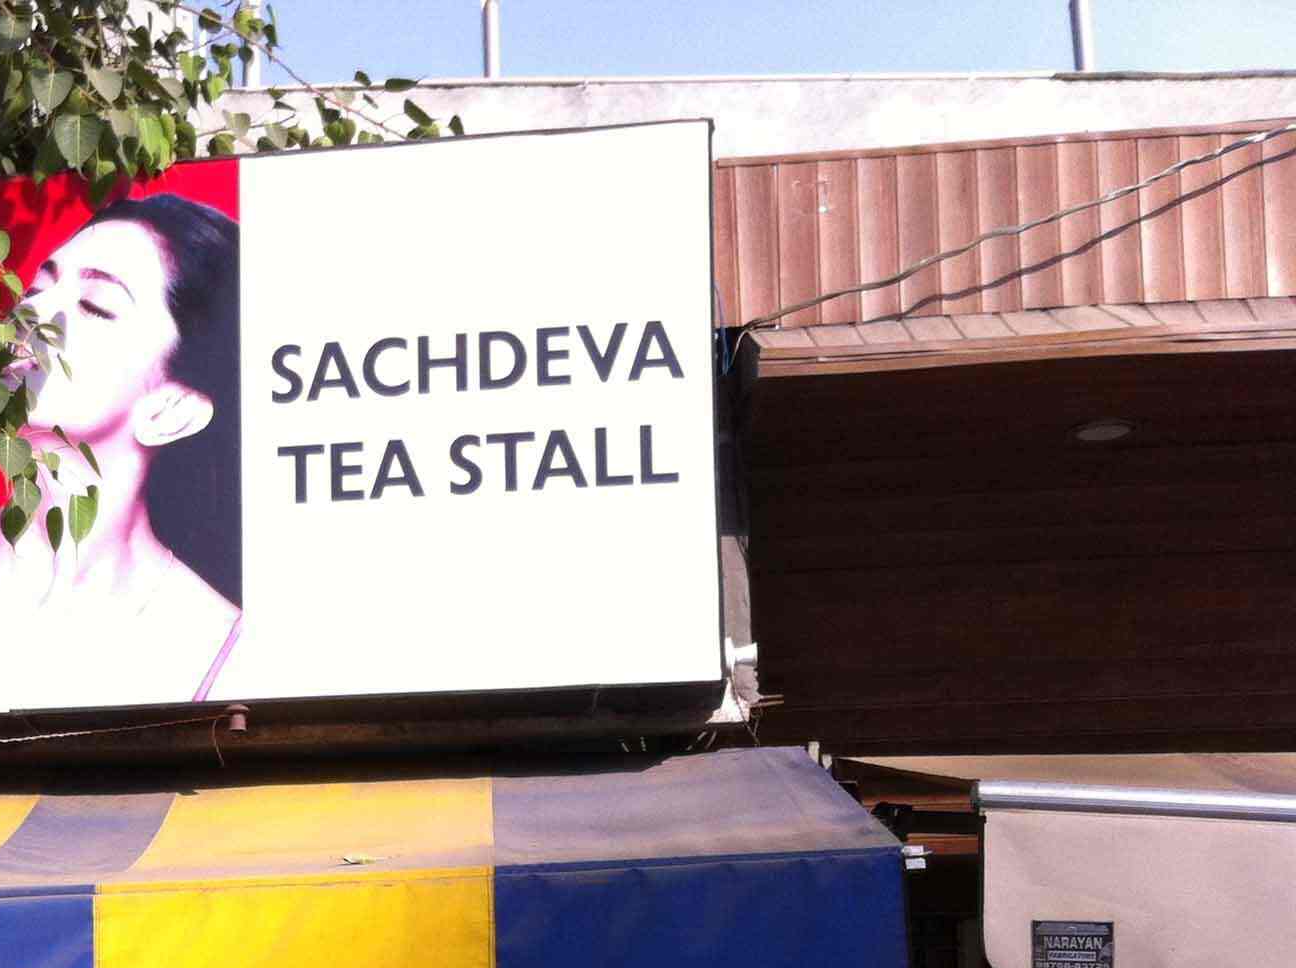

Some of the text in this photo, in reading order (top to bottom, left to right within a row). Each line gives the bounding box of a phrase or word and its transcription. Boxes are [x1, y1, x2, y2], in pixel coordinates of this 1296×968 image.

[271, 320, 685, 404] SACHDEVA
[277, 424, 680, 504] TEA STALL
[1044, 935, 1104, 950] NARAYAN
